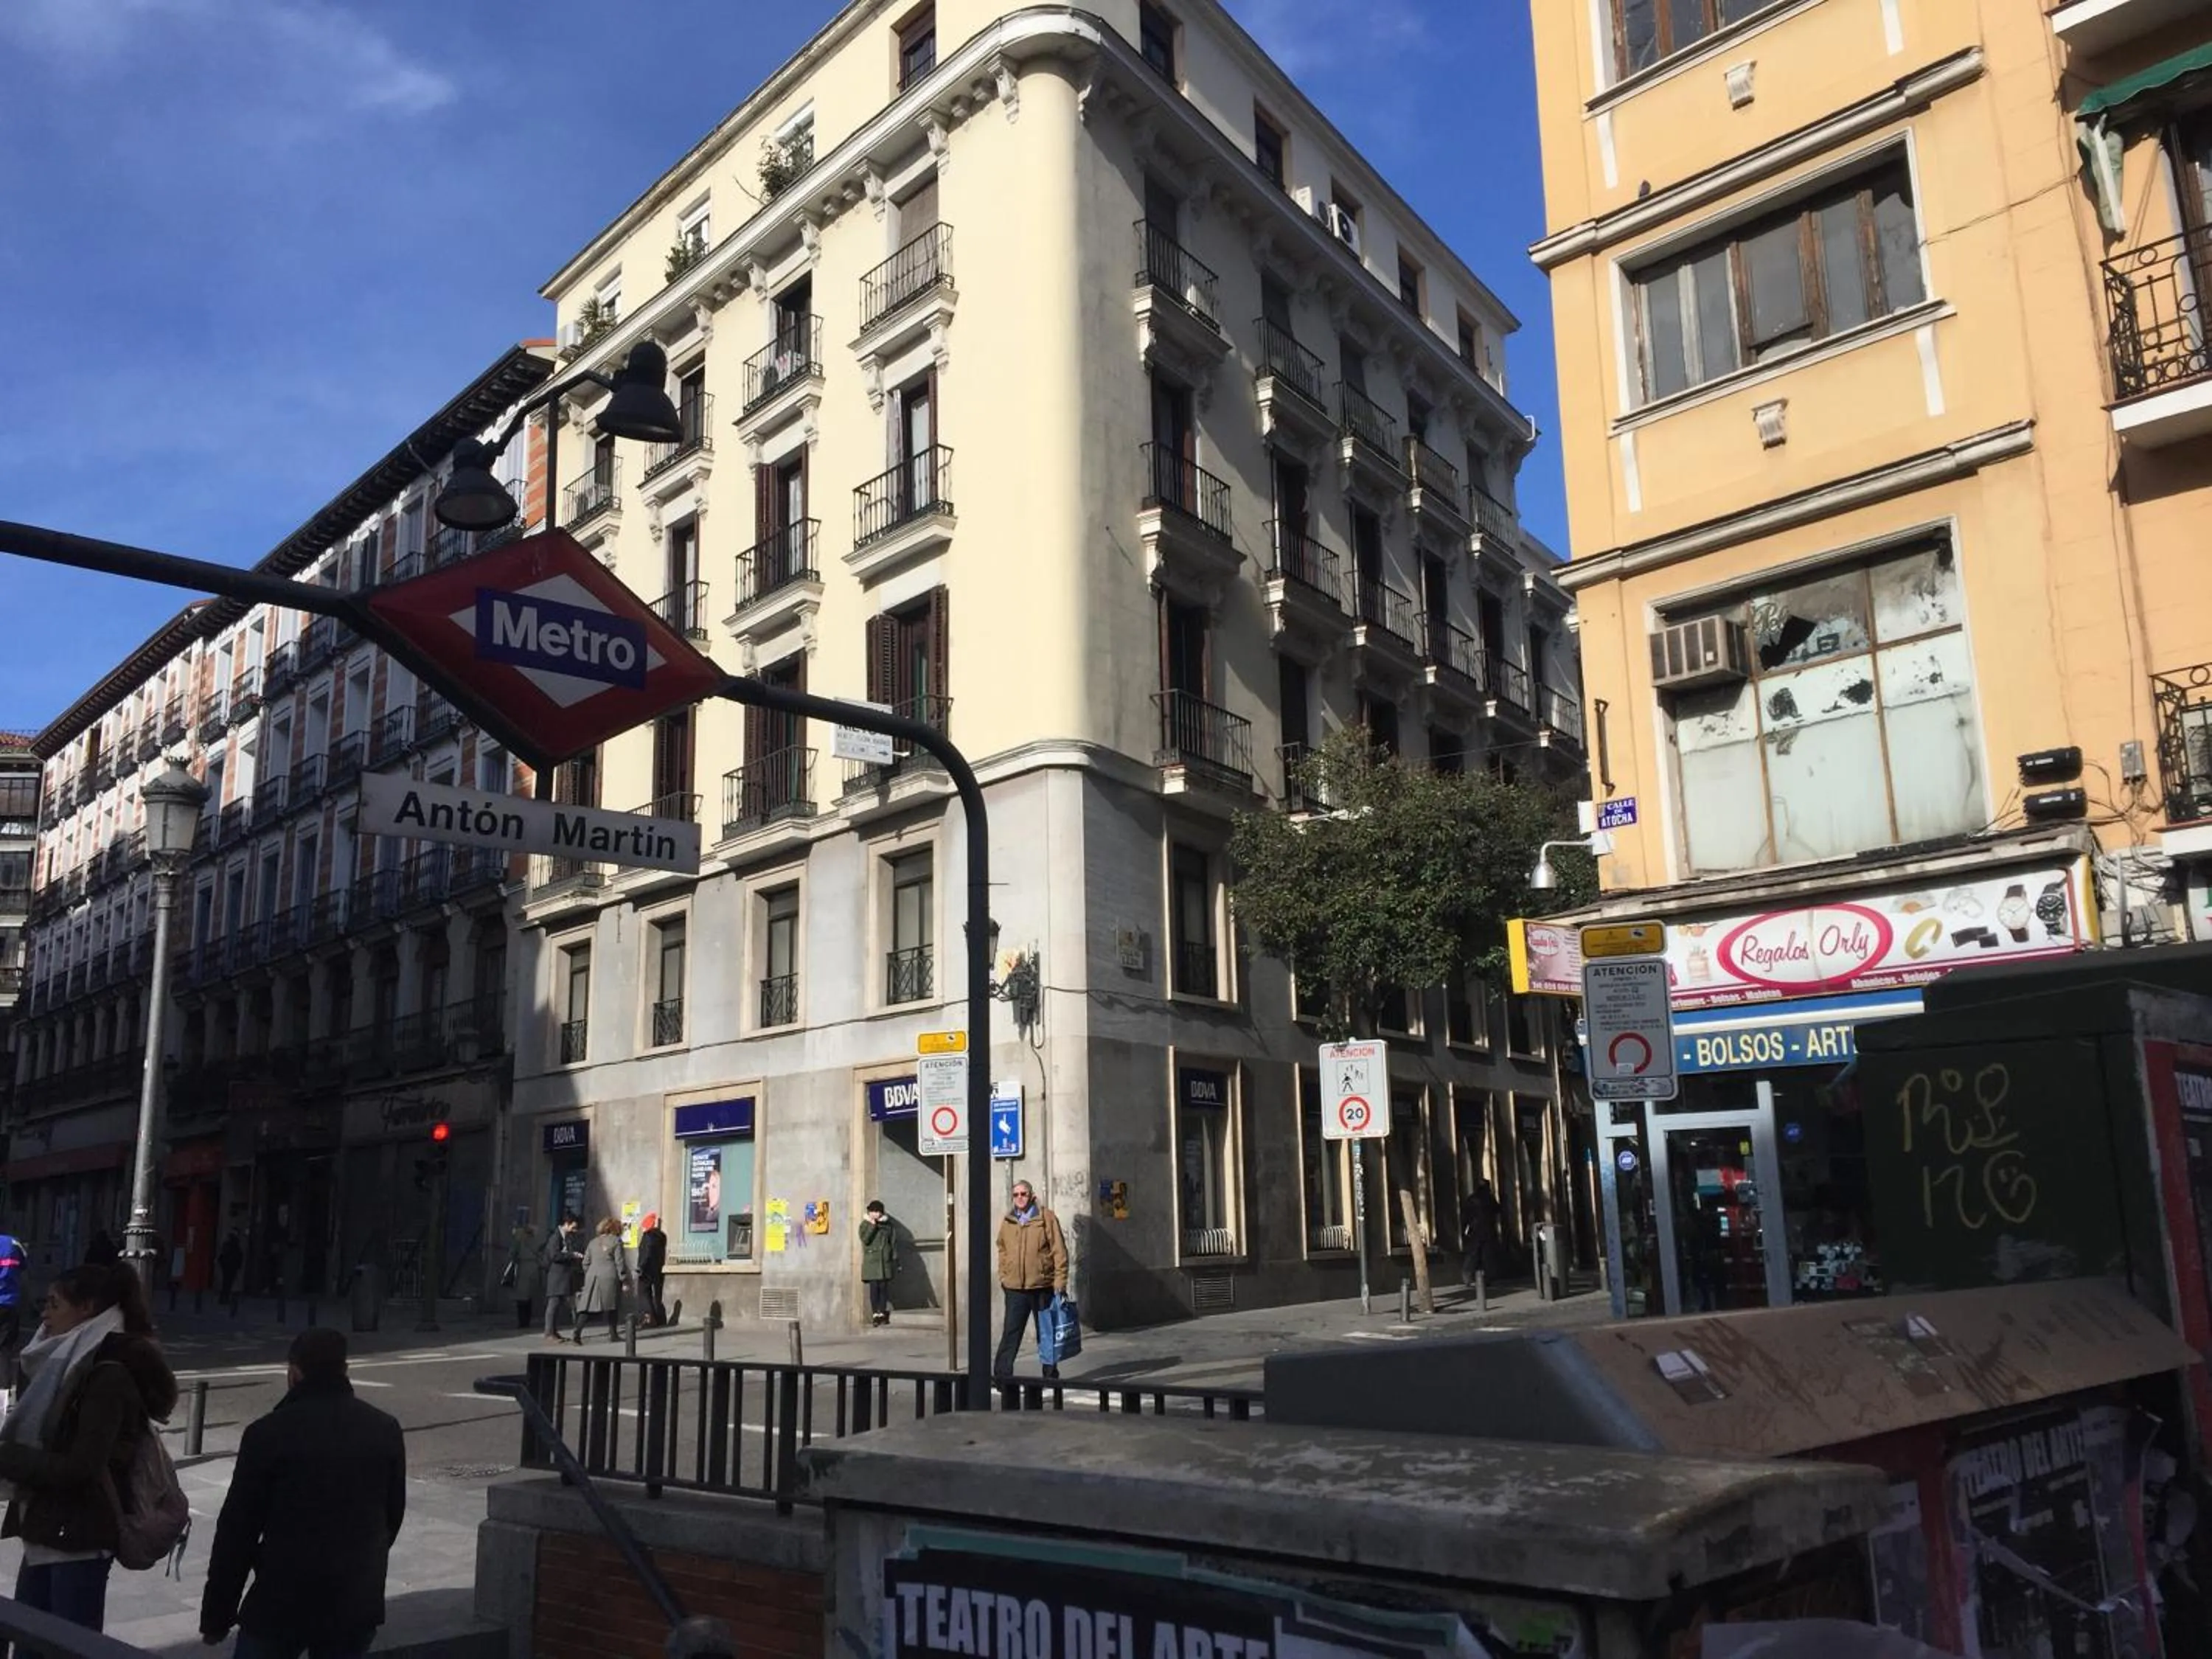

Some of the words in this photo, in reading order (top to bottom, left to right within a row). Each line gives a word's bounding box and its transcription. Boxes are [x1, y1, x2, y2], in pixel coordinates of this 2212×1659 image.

[493, 599, 635, 670] Metro
[1601, 812, 1634, 827] ATOCHA
[1607, 799, 1635, 810] CALLE
[394, 790, 524, 840] Antón
[552, 813, 675, 860] Martín
[1741, 931, 1809, 972] Regalos
[1820, 922, 1869, 959] Orly
[1697, 1032, 1785, 1067] BOLSOS
[884, 1083, 919, 1108] BBVA
[1346, 1108, 1364, 1120] 20
[896, 1582, 1052, 1659] TEATRO
[1063, 1604, 1134, 1659] DEL
[1152, 1621, 1270, 1659] AR
